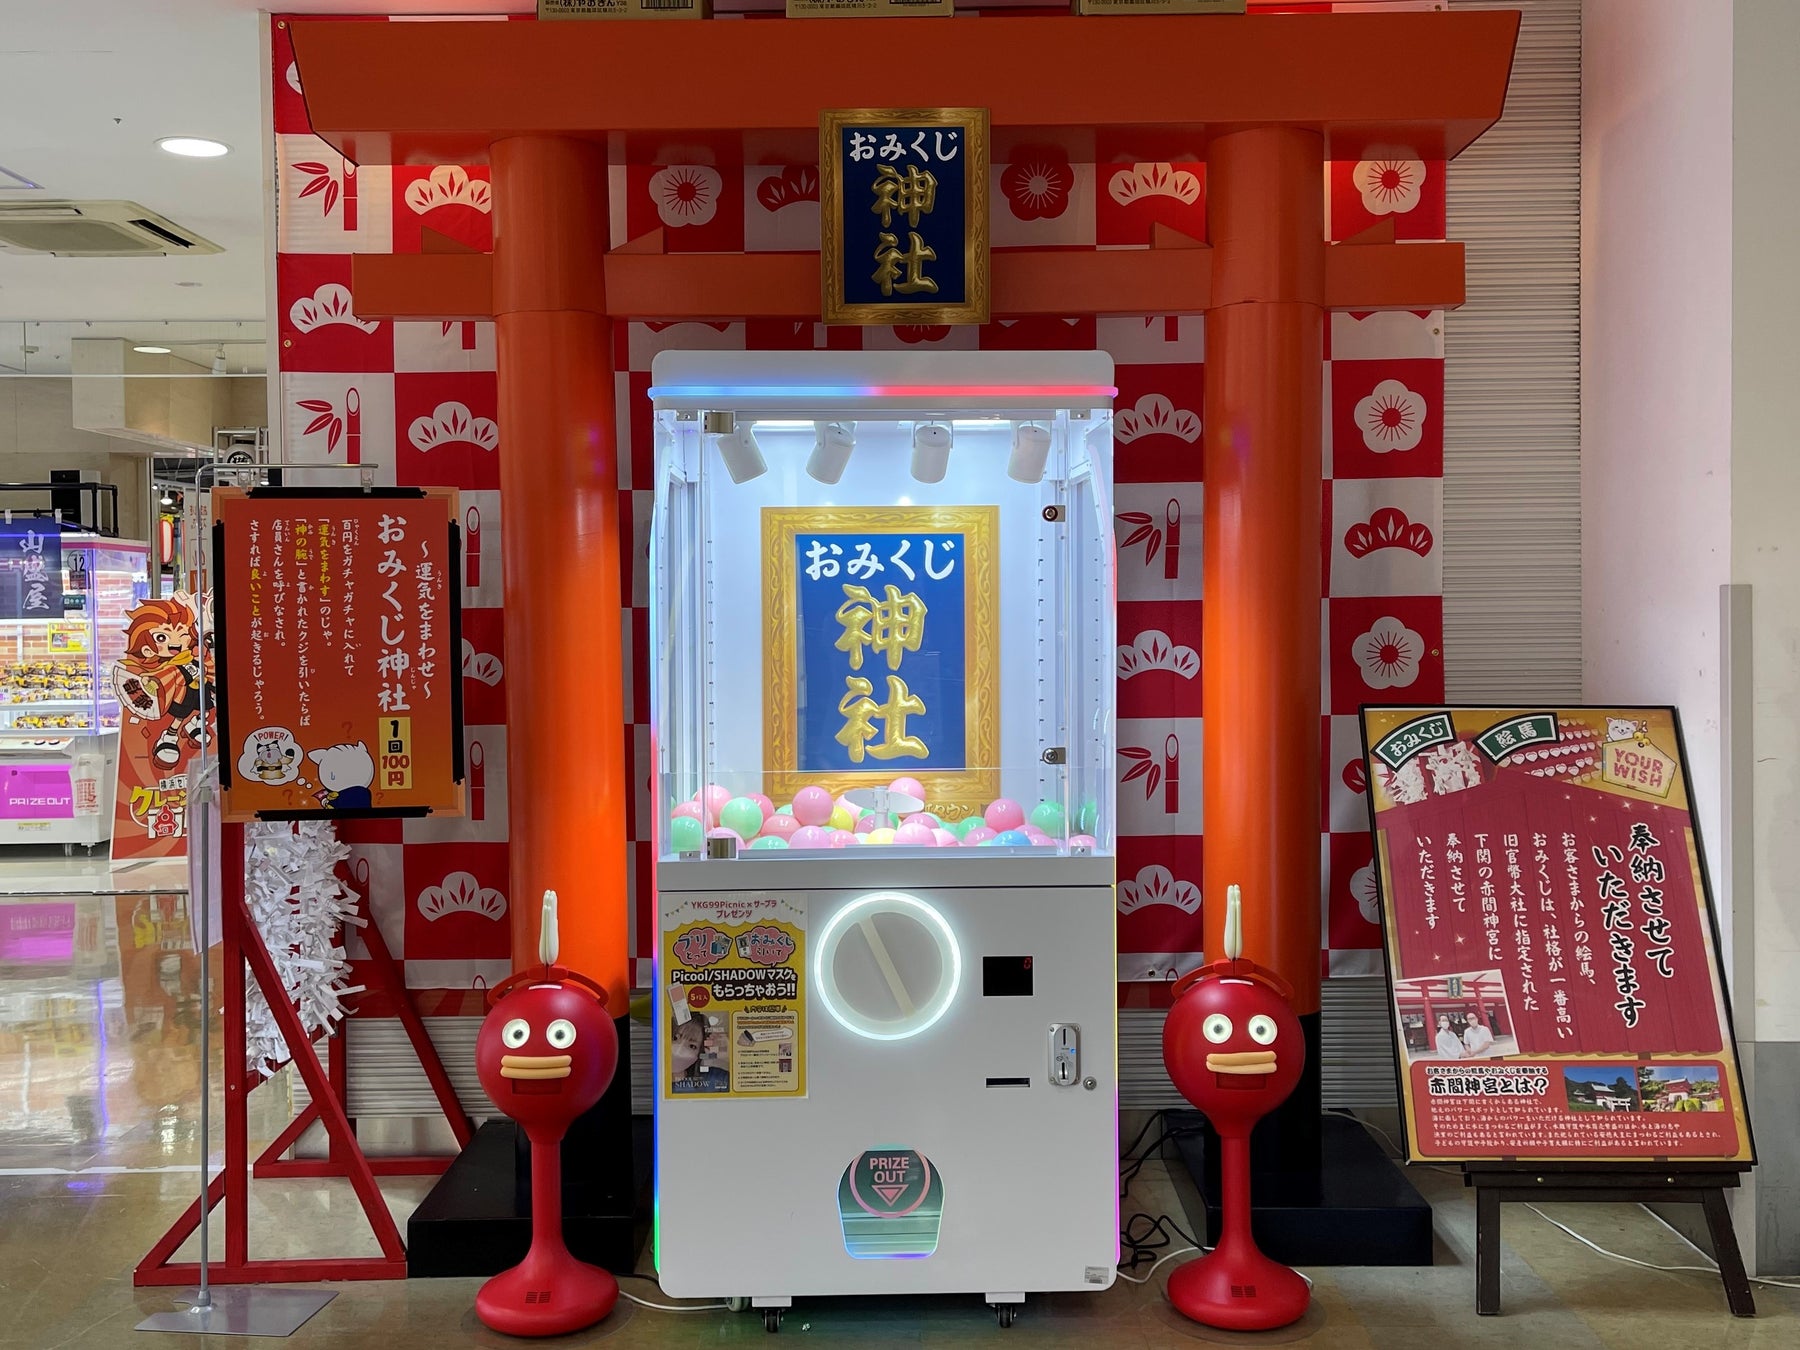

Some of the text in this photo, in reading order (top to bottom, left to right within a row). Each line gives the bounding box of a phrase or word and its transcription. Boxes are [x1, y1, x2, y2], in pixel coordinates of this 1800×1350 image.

[849, 131, 958, 162] おみくじ
[871, 163, 939, 296] 神社
[19, 529, 50, 610] 山盛屋
[272, 519, 286, 647] 店員さんを呼びなされ。
[318, 518, 333, 647] 「運気をまわす」のじゃ。
[342, 519, 356, 676] 百円をガチャガチャに入れて
[377, 513, 411, 713] おみくじ神社
[805, 539, 955, 581] おみくじ
[249, 519, 265, 720] さすれば良いことが起きるじゃろう。
[834, 583, 930, 763] 神社
[160, 778, 187, 790] 横浜セ
[257, 731, 286, 741] POWER
[1389, 721, 1445, 758] おみくじ
[1495, 720, 1539, 749] 絵馬
[1613, 762, 1663, 788] WISH
[1614, 748, 1664, 774] YOUR
[1416, 836, 1439, 930] いただきます
[1446, 833, 1466, 913] 奉納させて
[1474, 833, 1503, 961] 下関の赤間神宮に
[1503, 833, 1540, 1011] 旧官幣大社に指定された
[1562, 832, 1596, 985] お客さまからの絵馬、
[1628, 823, 1674, 978] 奉納させて
[1532, 832, 1574, 1039] おみくじは、社格が一番高い
[1592, 846, 1646, 1028] いただきます
[869, 1157, 909, 1170] PRIZE
[873, 1170, 905, 1183] OUT
